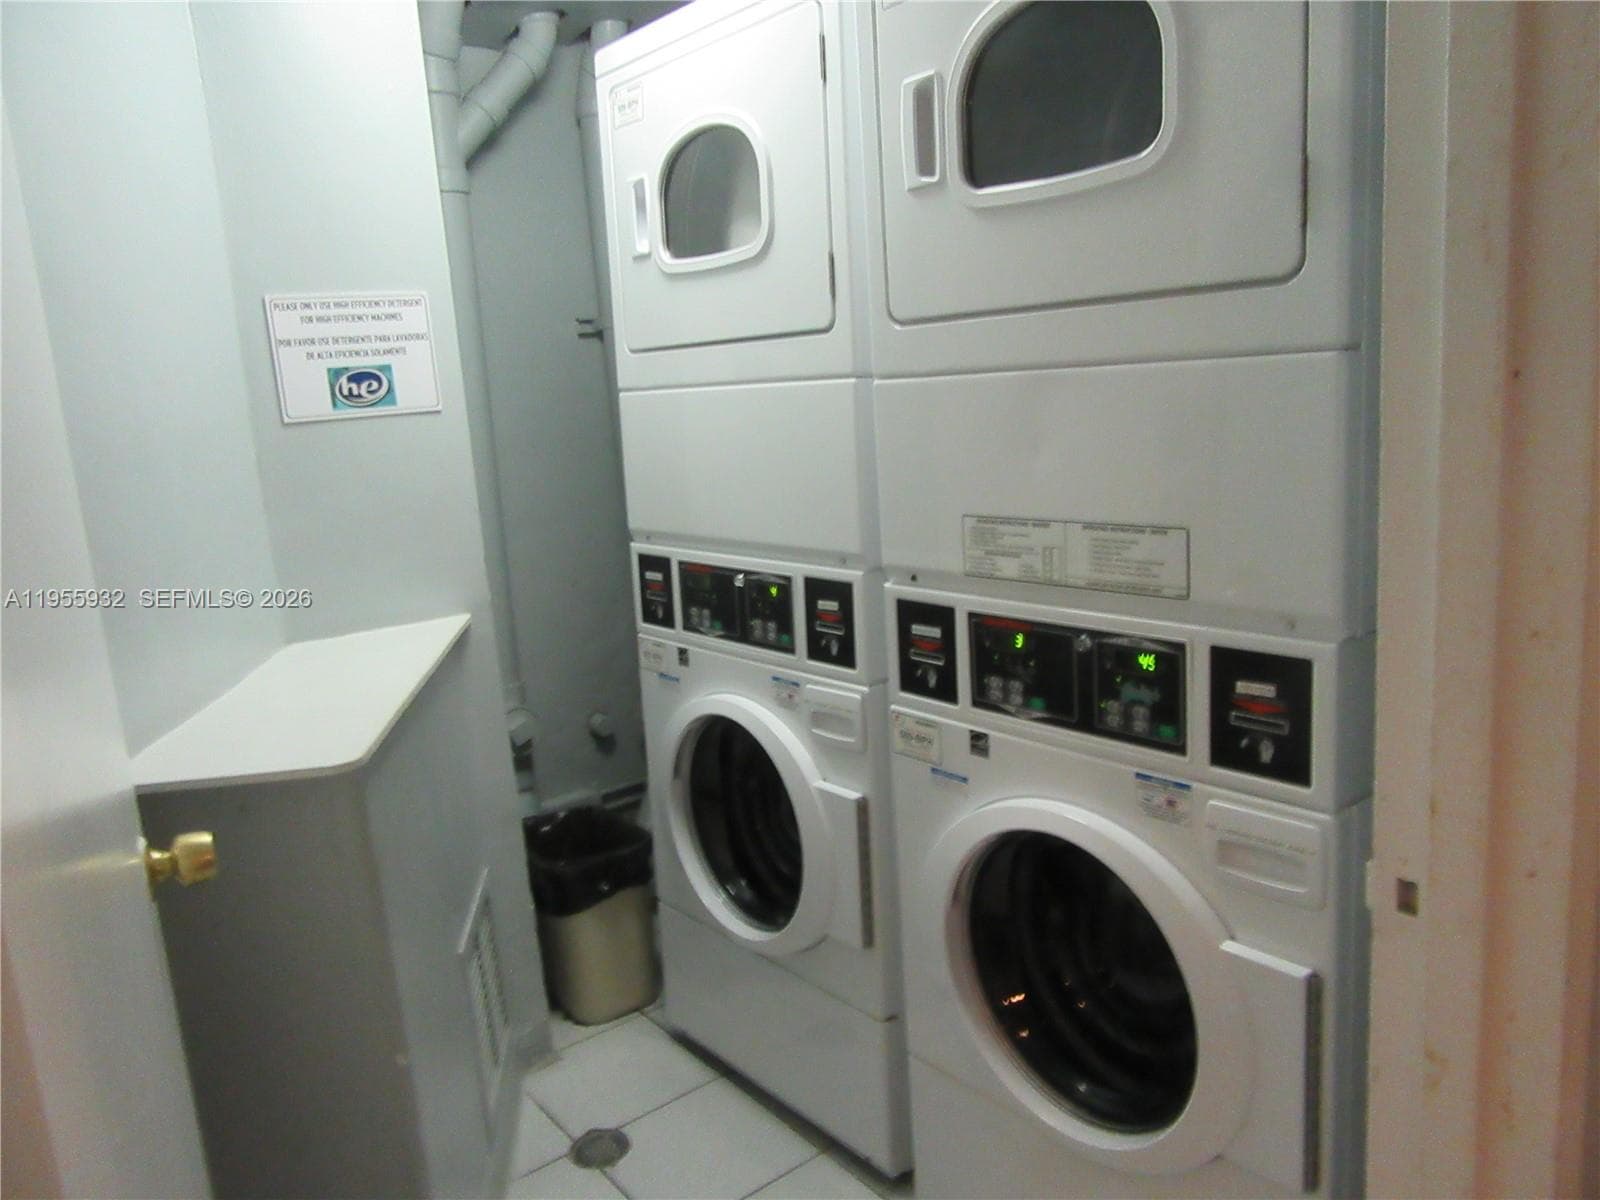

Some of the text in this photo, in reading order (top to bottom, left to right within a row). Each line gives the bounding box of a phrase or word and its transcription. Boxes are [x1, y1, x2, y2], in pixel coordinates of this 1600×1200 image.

[273, 299, 422, 311] PLEASE ONLY USE HIGH EFFICIENCY DETERGENT
[300, 313, 404, 324] FOR HIGH EFFICIENCY MACHINES
[278, 333, 429, 347] POR FAVOR USE DETERGENTE PARA LAVADORAS
[306, 348, 407, 360] DE ALTA EFICIENCIA SOLAMENTE
[341, 377, 380, 400] he
[1014, 632, 1024, 649] 3
